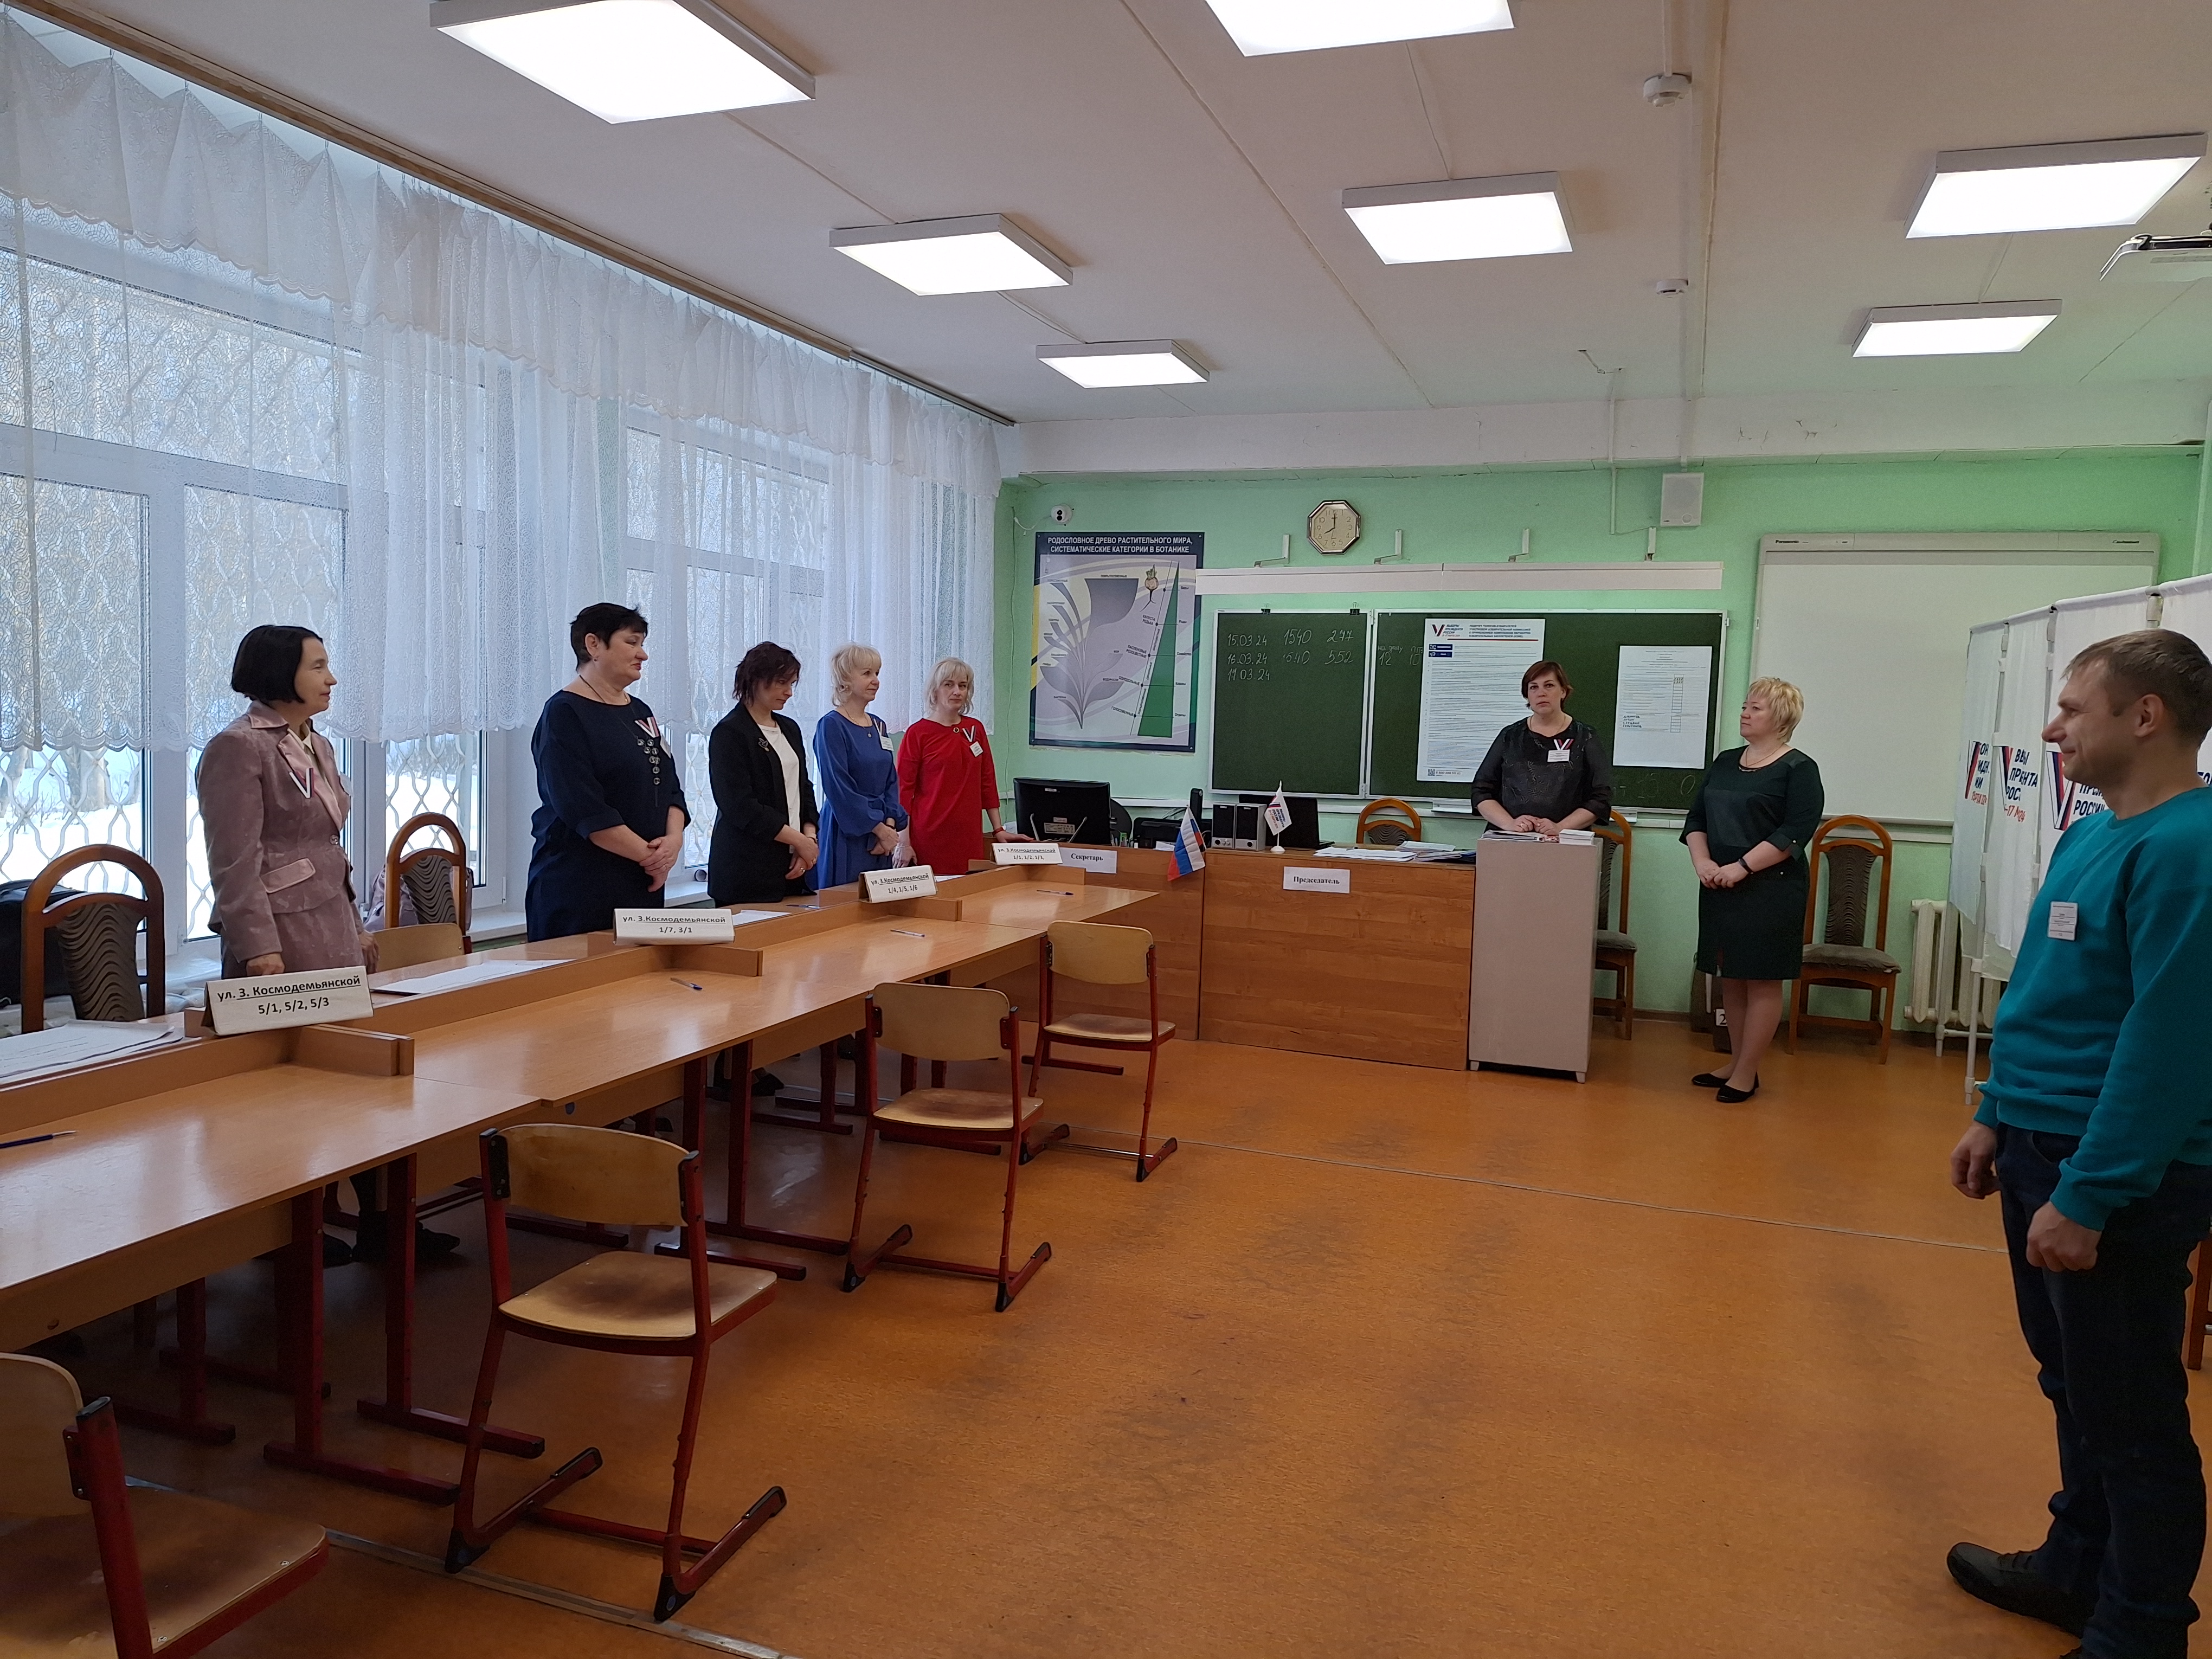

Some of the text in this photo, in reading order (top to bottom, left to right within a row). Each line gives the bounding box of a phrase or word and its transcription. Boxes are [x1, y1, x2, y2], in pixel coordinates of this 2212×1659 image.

[1284, 629, 1312, 645] 1540
[1327, 629, 1354, 642] 277
[1324, 650, 1353, 665] 552
[1379, 652, 1391, 665] 12
[217, 991, 236, 1001] ул.
[253, 975, 361, 995] Космодемьянской
[258, 997, 329, 1015] 5/1, 5/2, 5/3
